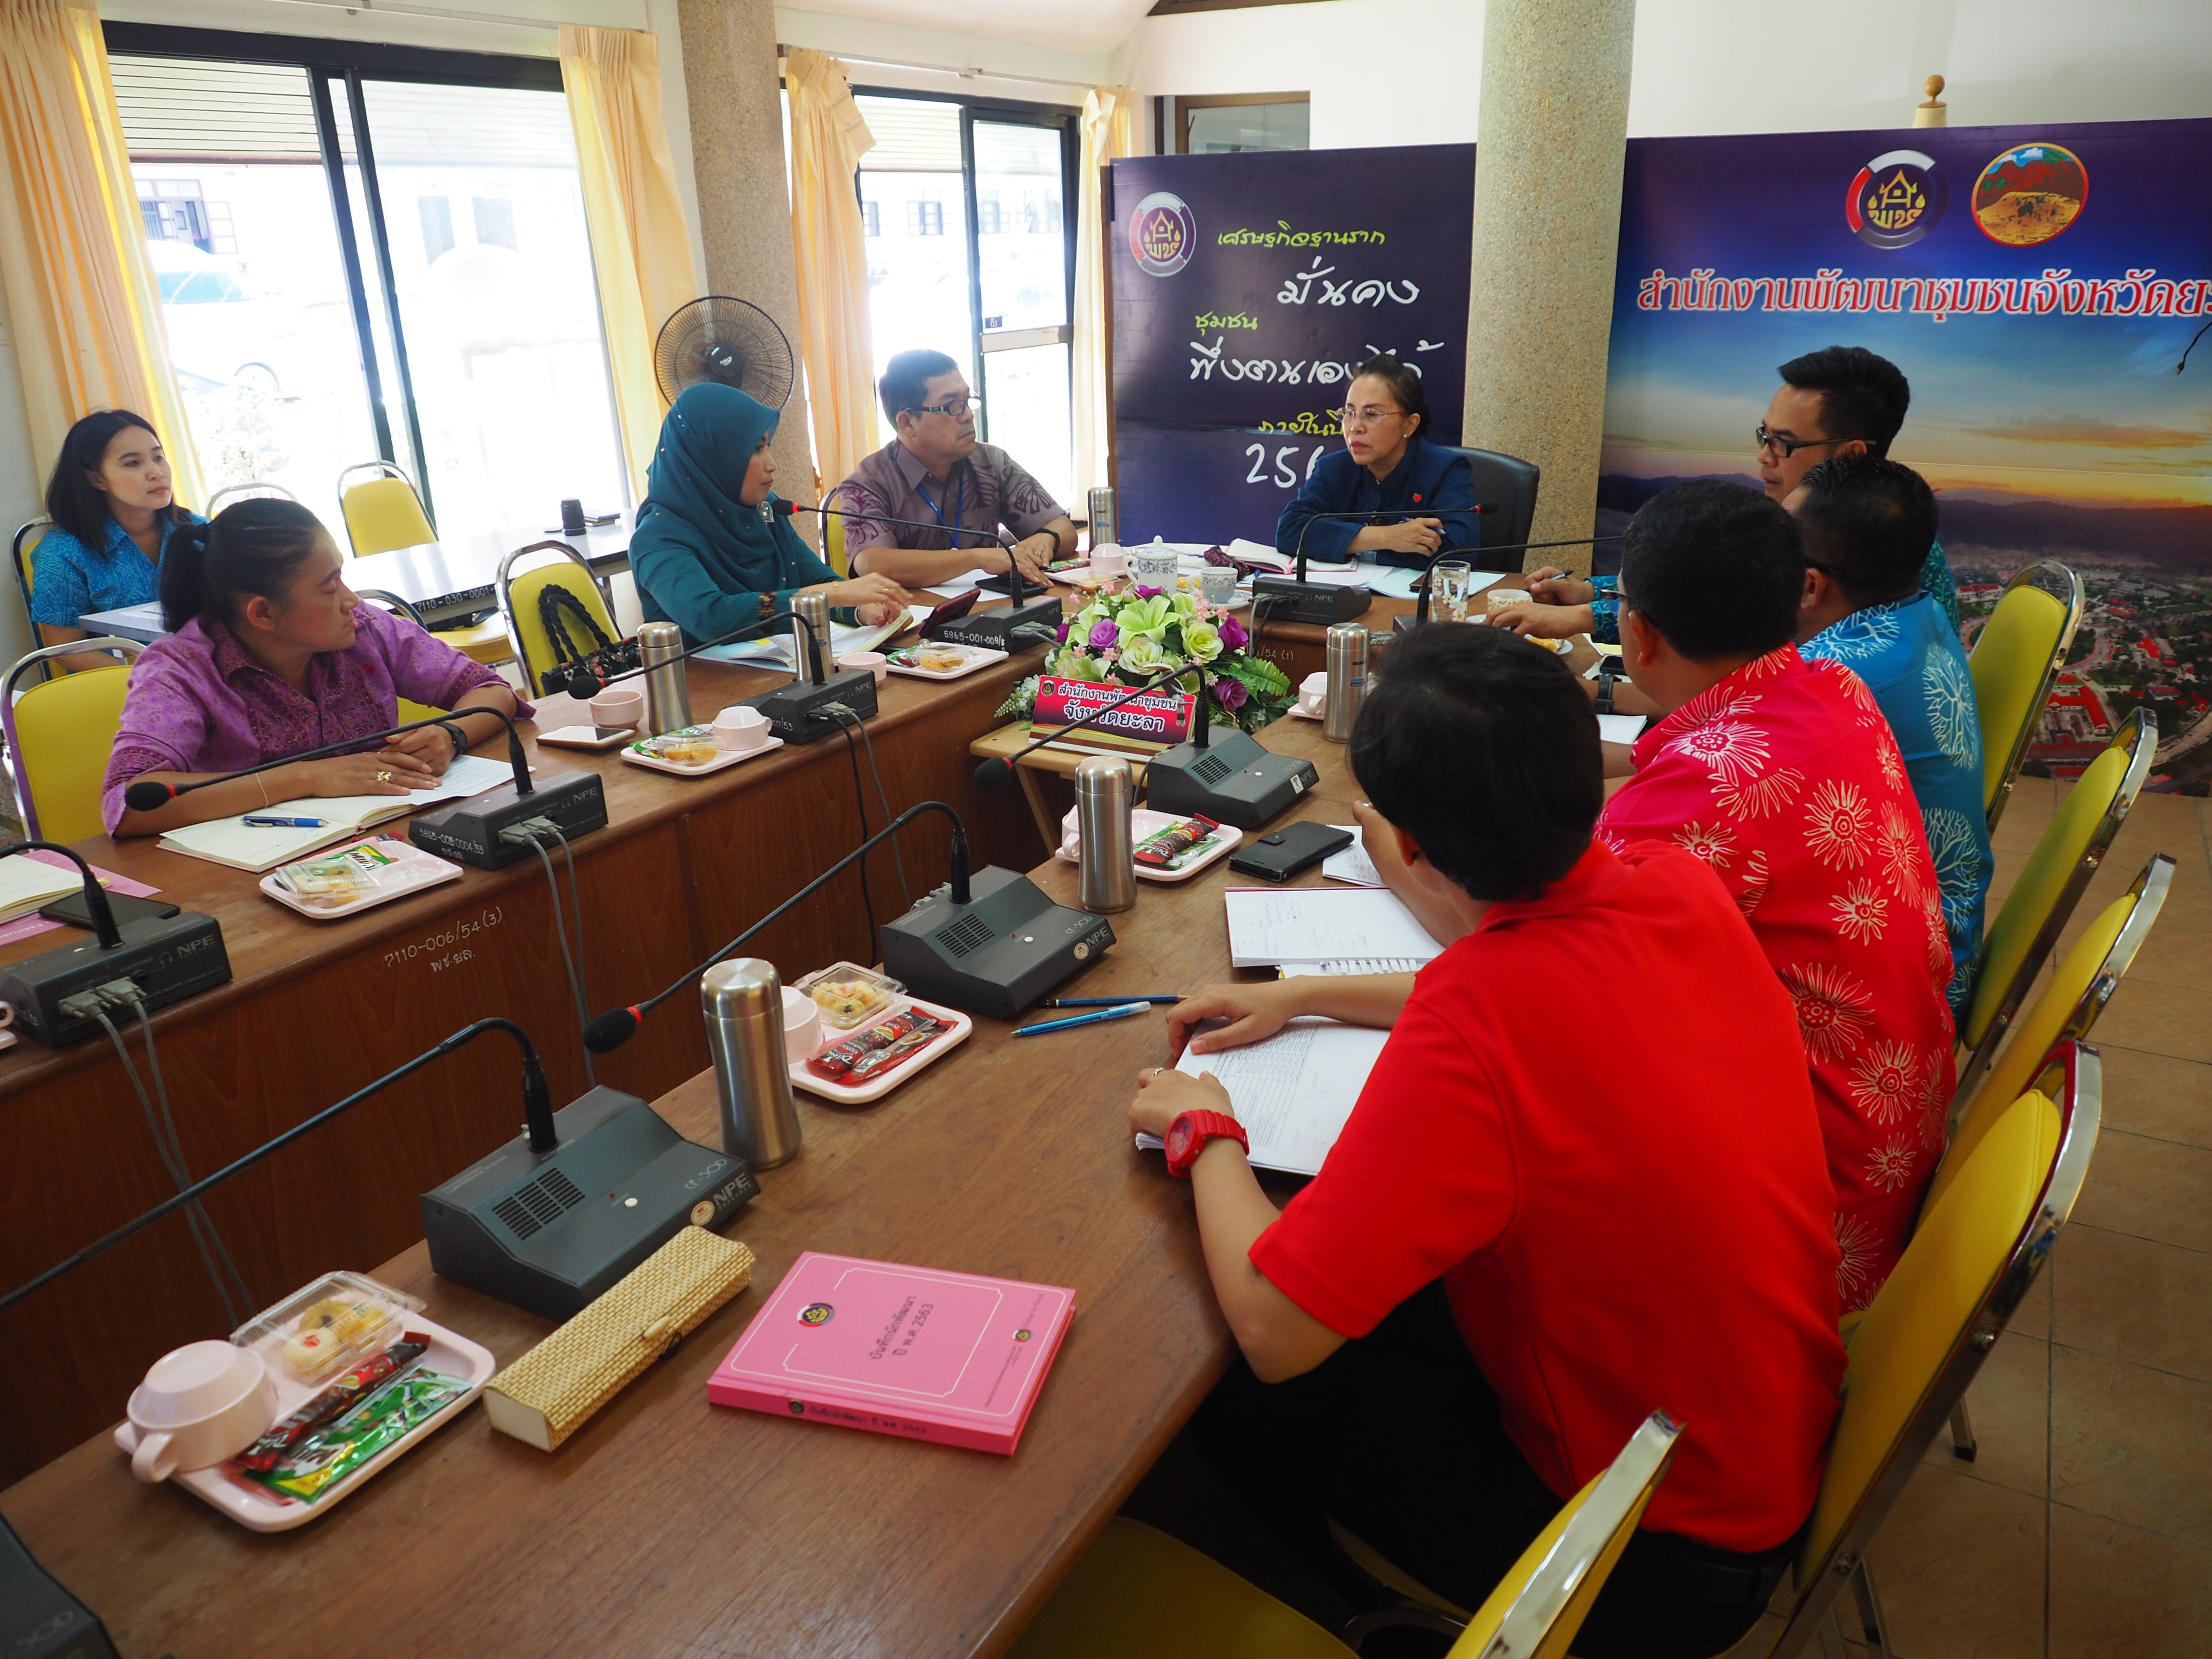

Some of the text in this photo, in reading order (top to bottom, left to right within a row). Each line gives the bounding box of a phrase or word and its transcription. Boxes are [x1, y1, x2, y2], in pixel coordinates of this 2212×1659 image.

[1218, 220, 1385, 248] เศรษฐกิจฐานราก
[1277, 256, 1420, 306] มั่นคง
[1195, 311, 1258, 337] ชุมชน
[855, 681, 871, 692] NPE
[573, 787, 598, 801] NPE
[177, 935, 215, 955] NPE
[1086, 926, 1109, 947] NPE
[713, 1173, 749, 1206] NPE
[912, 1303, 934, 1326] 2563
